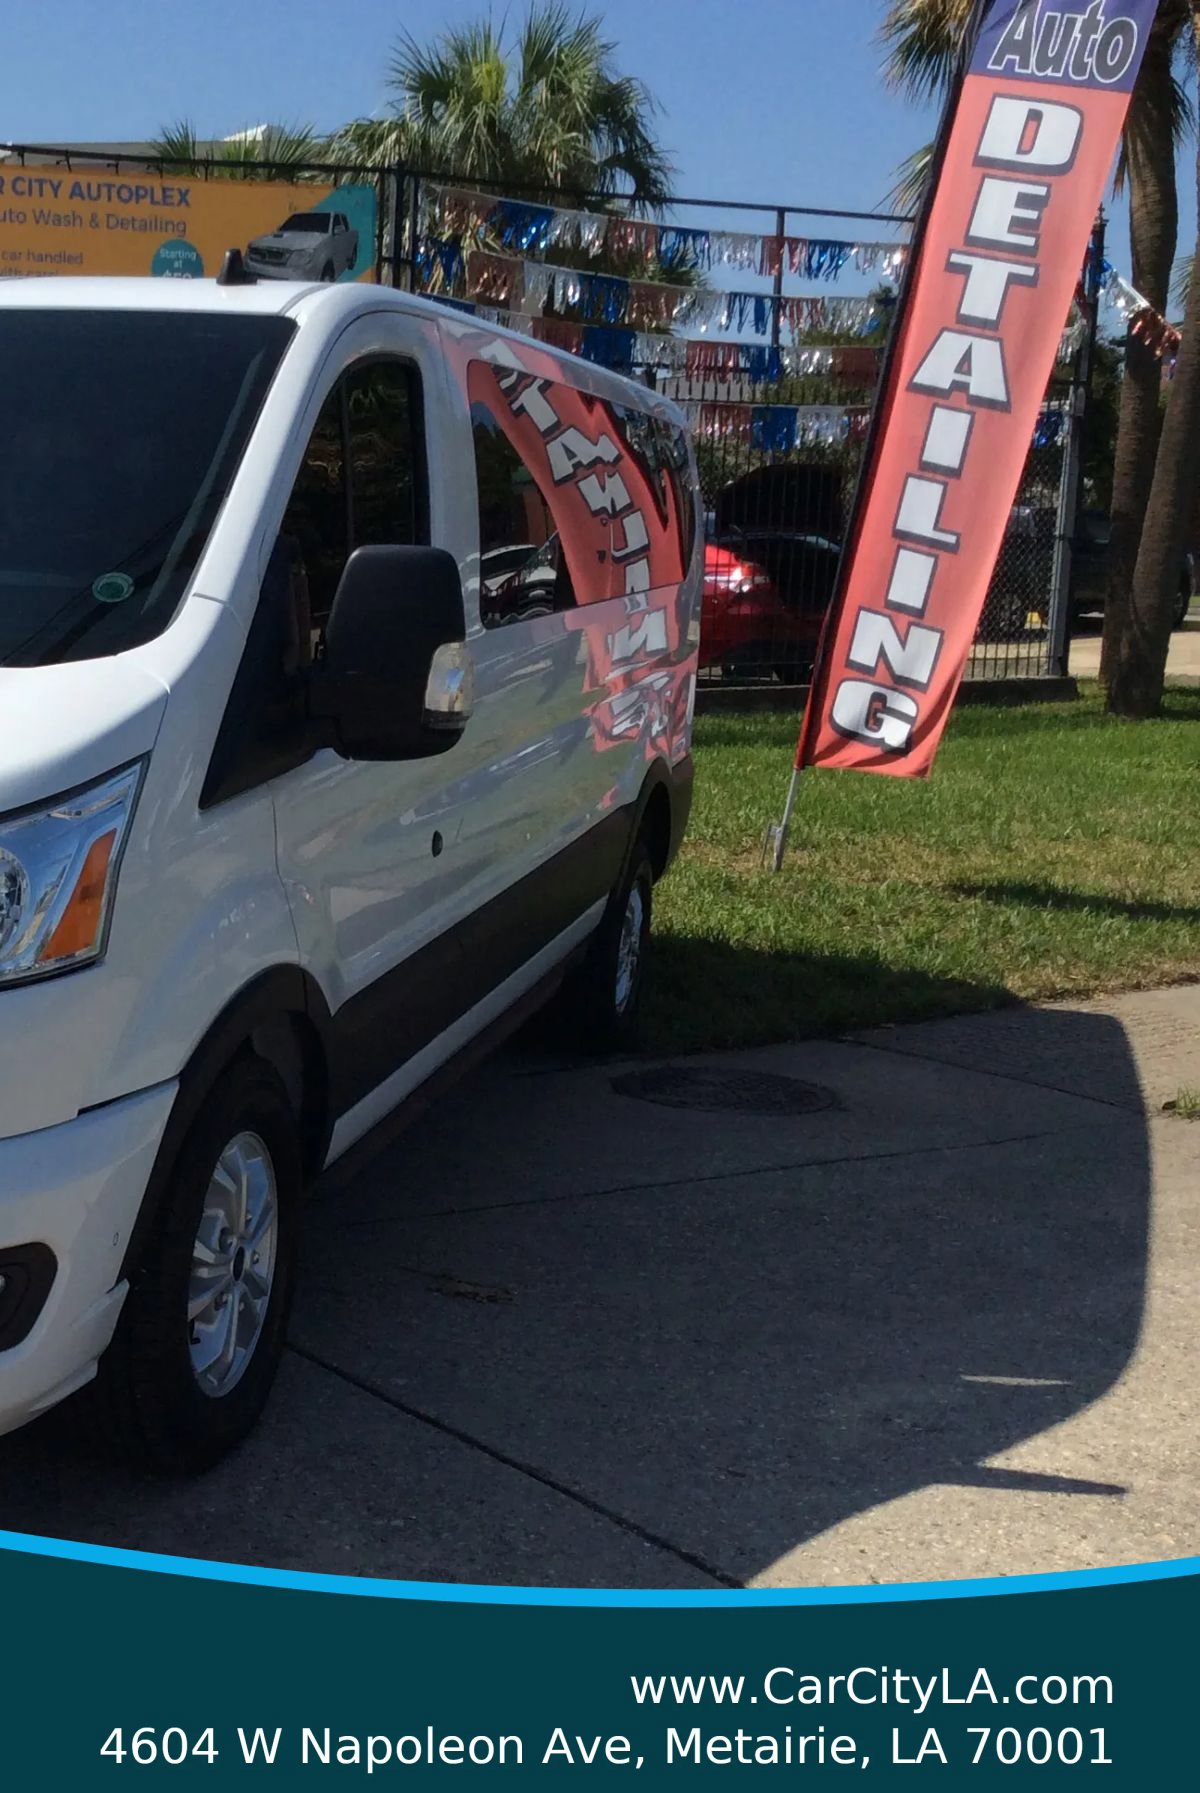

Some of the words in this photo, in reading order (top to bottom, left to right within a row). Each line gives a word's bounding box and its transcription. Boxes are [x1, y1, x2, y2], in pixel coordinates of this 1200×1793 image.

[987, 0, 1138, 84] Auto
[11, 177, 63, 199] CITY
[68, 181, 191, 207] AUTOPLEX
[32, 209, 84, 228] Wash
[89, 214, 99, 229] &
[106, 213, 188, 236] Detailing
[1, 250, 22, 262] car
[27, 248, 84, 265] handled
[831, 92, 1084, 755] DETAILING
